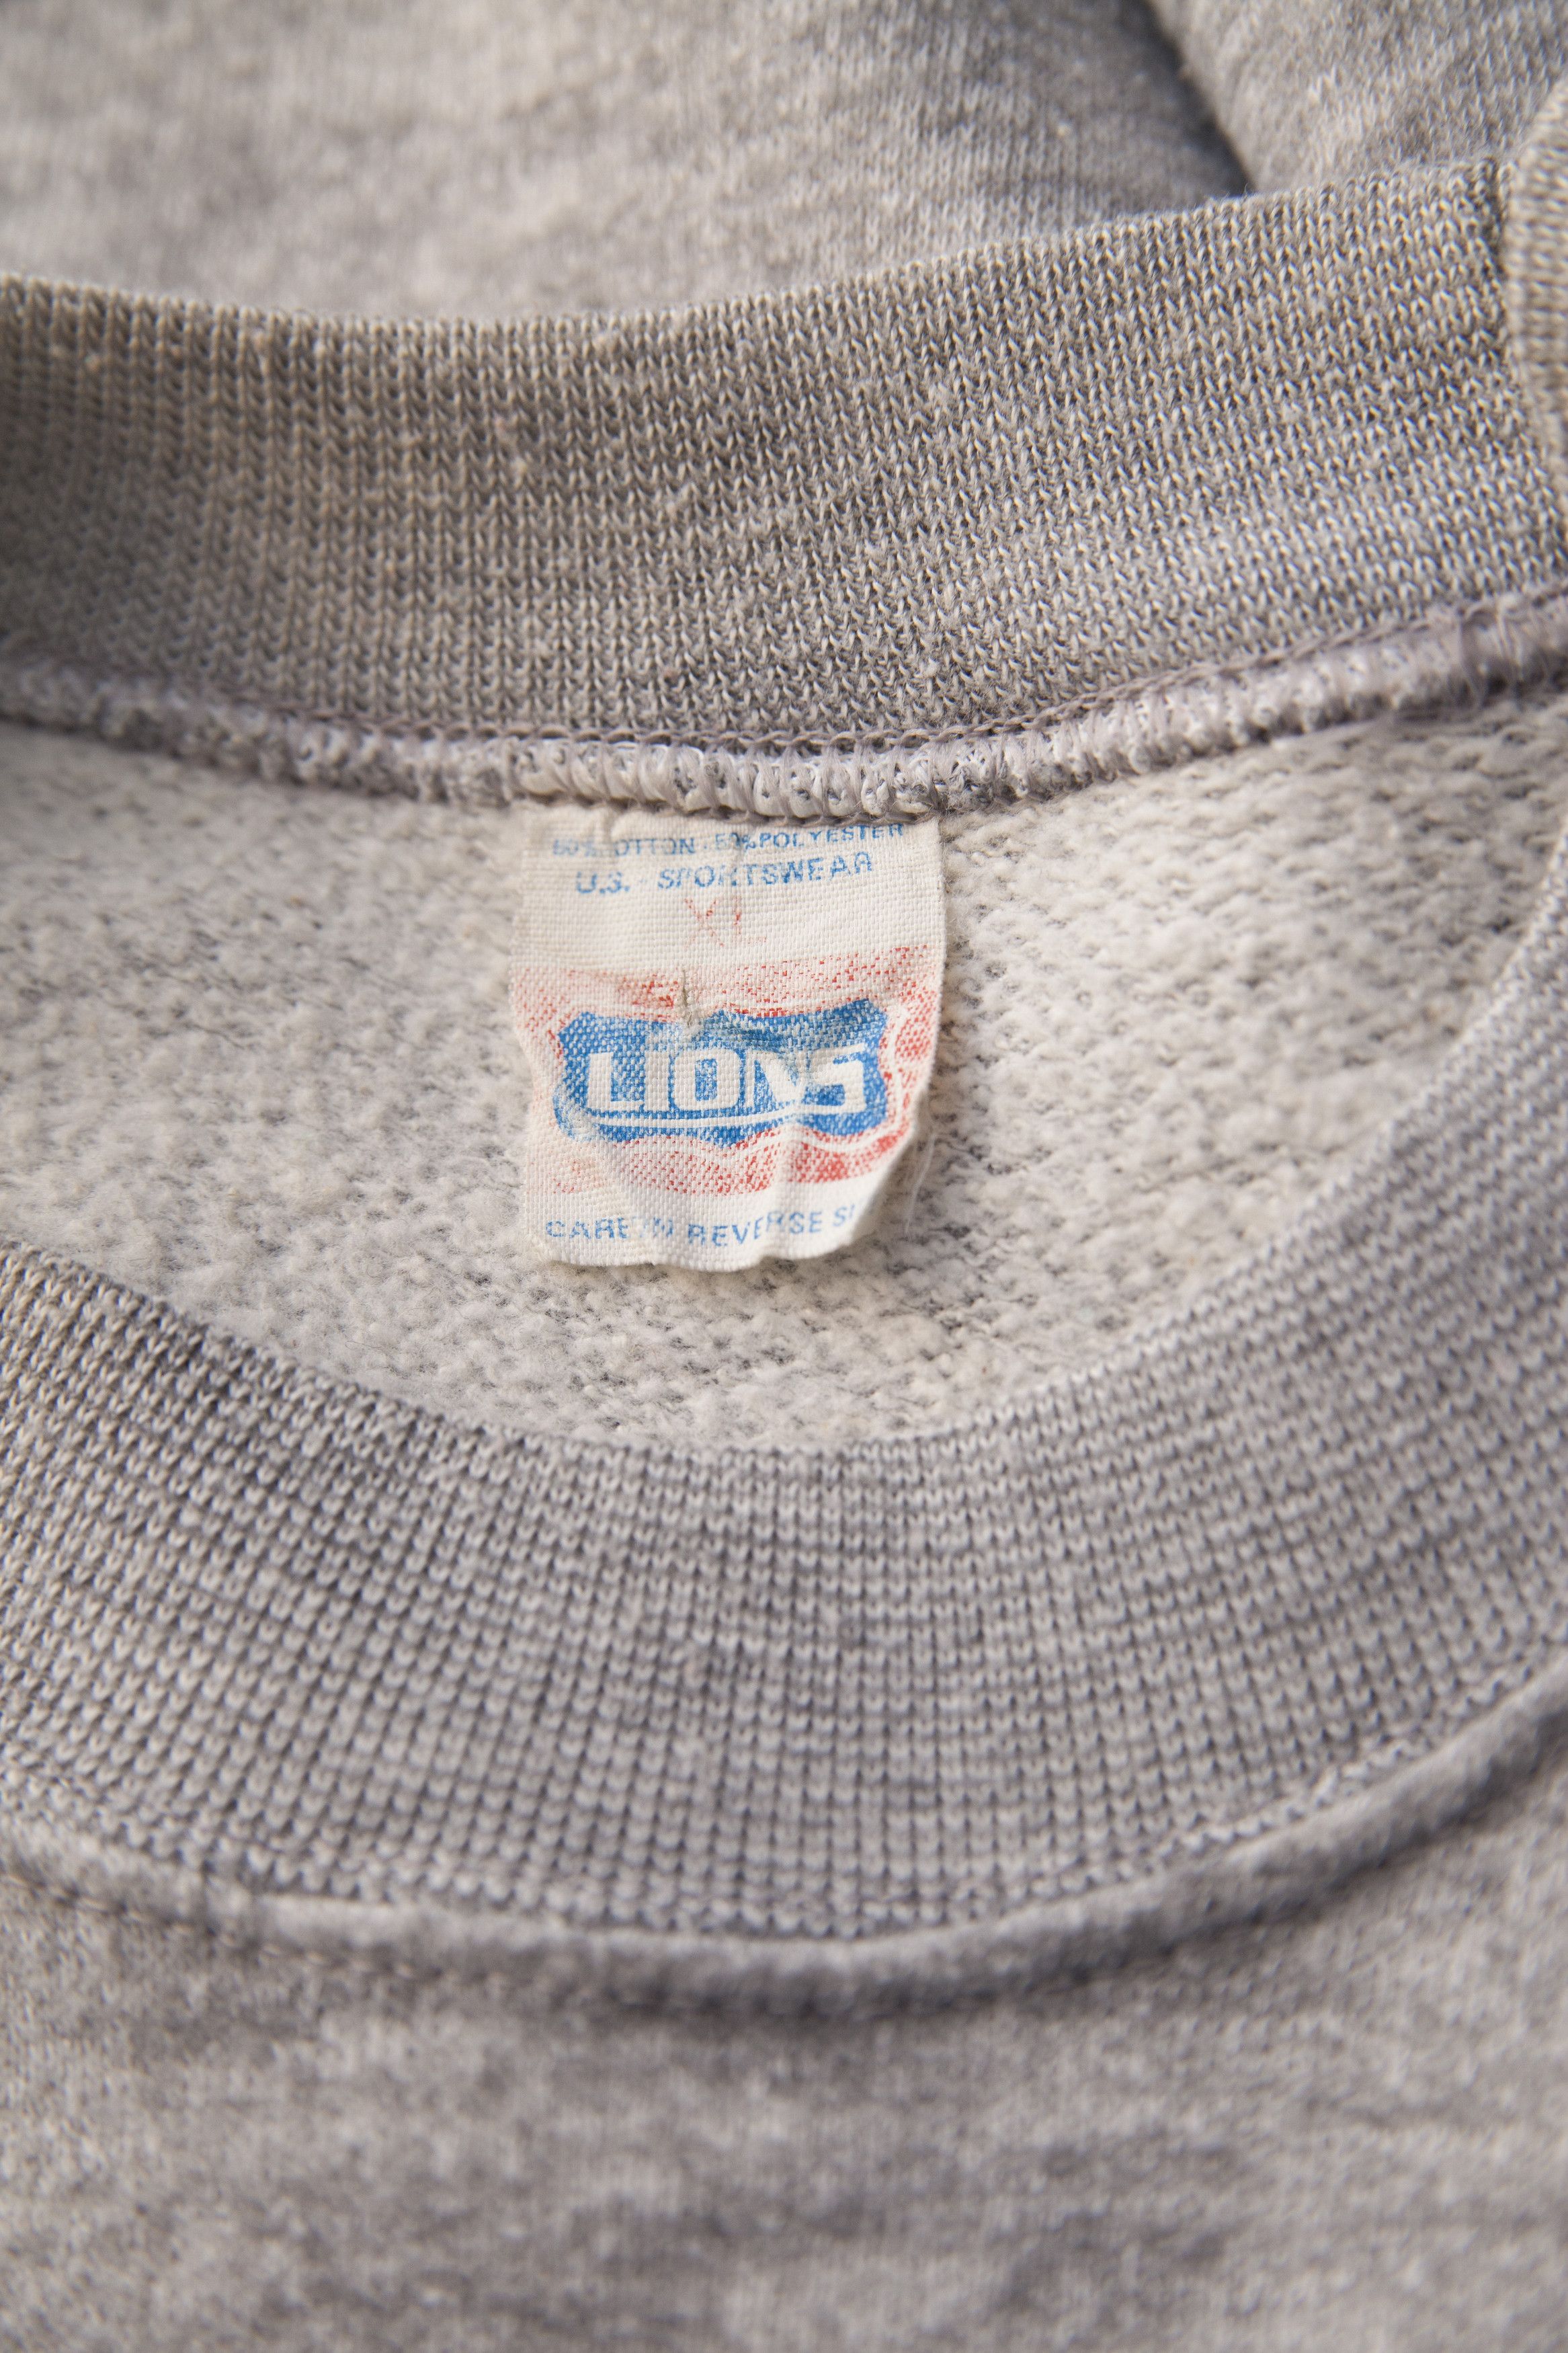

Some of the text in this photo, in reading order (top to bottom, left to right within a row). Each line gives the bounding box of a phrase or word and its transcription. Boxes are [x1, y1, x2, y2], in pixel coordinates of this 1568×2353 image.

[600, 837, 696, 856] OTTON
[657, 851, 872, 889] SPORTSWEAR
[586, 1044, 867, 1113] LIONS
[546, 1216, 629, 1240] CARE
[688, 1210, 823, 1248] REVERSE
